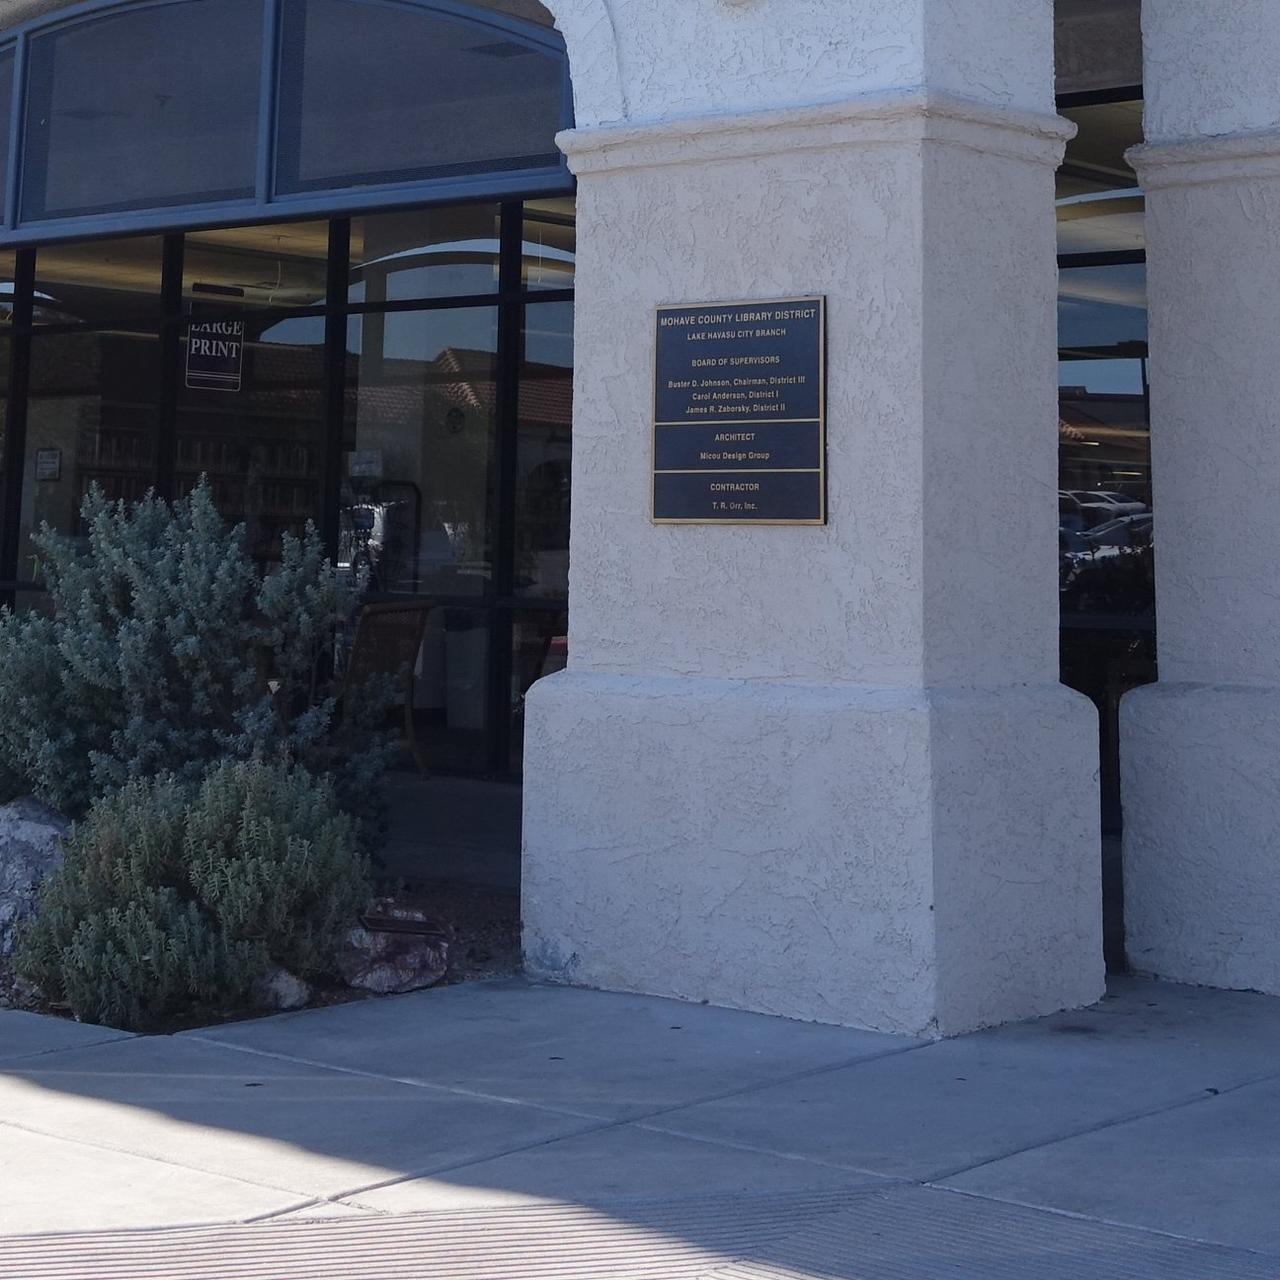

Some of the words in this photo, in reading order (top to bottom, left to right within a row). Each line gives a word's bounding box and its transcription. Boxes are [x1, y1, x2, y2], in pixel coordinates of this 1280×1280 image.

[661, 316, 695, 326] MOHAVE
[698, 314, 733, 324] COUNTY
[735, 312, 772, 322] LIBRARY
[775, 309, 815, 320] DISTRICT
[191, 321, 241, 335] LARGE
[687, 332, 705, 340] LAKE
[708, 330, 735, 339] HAVASU
[737, 330, 754, 338] CITY
[755, 328, 786, 337] BRANCH
[191, 338, 240, 357] PRINT
[692, 359, 716, 367] BOARD
[718, 358, 728, 366] OF
[730, 355, 780, 366] SUPERVISORS
[668, 380, 690, 388] Buster
[700, 379, 732, 388] Johnson,
[734, 377, 768, 386] Chairman,
[770, 376, 796, 384] District
[797, 375, 805, 383] III
[712, 392, 747, 400] Anderson,
[749, 390, 775, 399] District
[686, 406, 708, 414] James
[709, 405, 717, 413] R.
[753, 404, 779, 412] District
[714, 433, 755, 441] ARCHITECT
[722, 452, 747, 461] Design
[748, 451, 770, 460] Group
[710, 483, 760, 491] CONTRACTOR
[744, 502, 758, 510] Inc.
